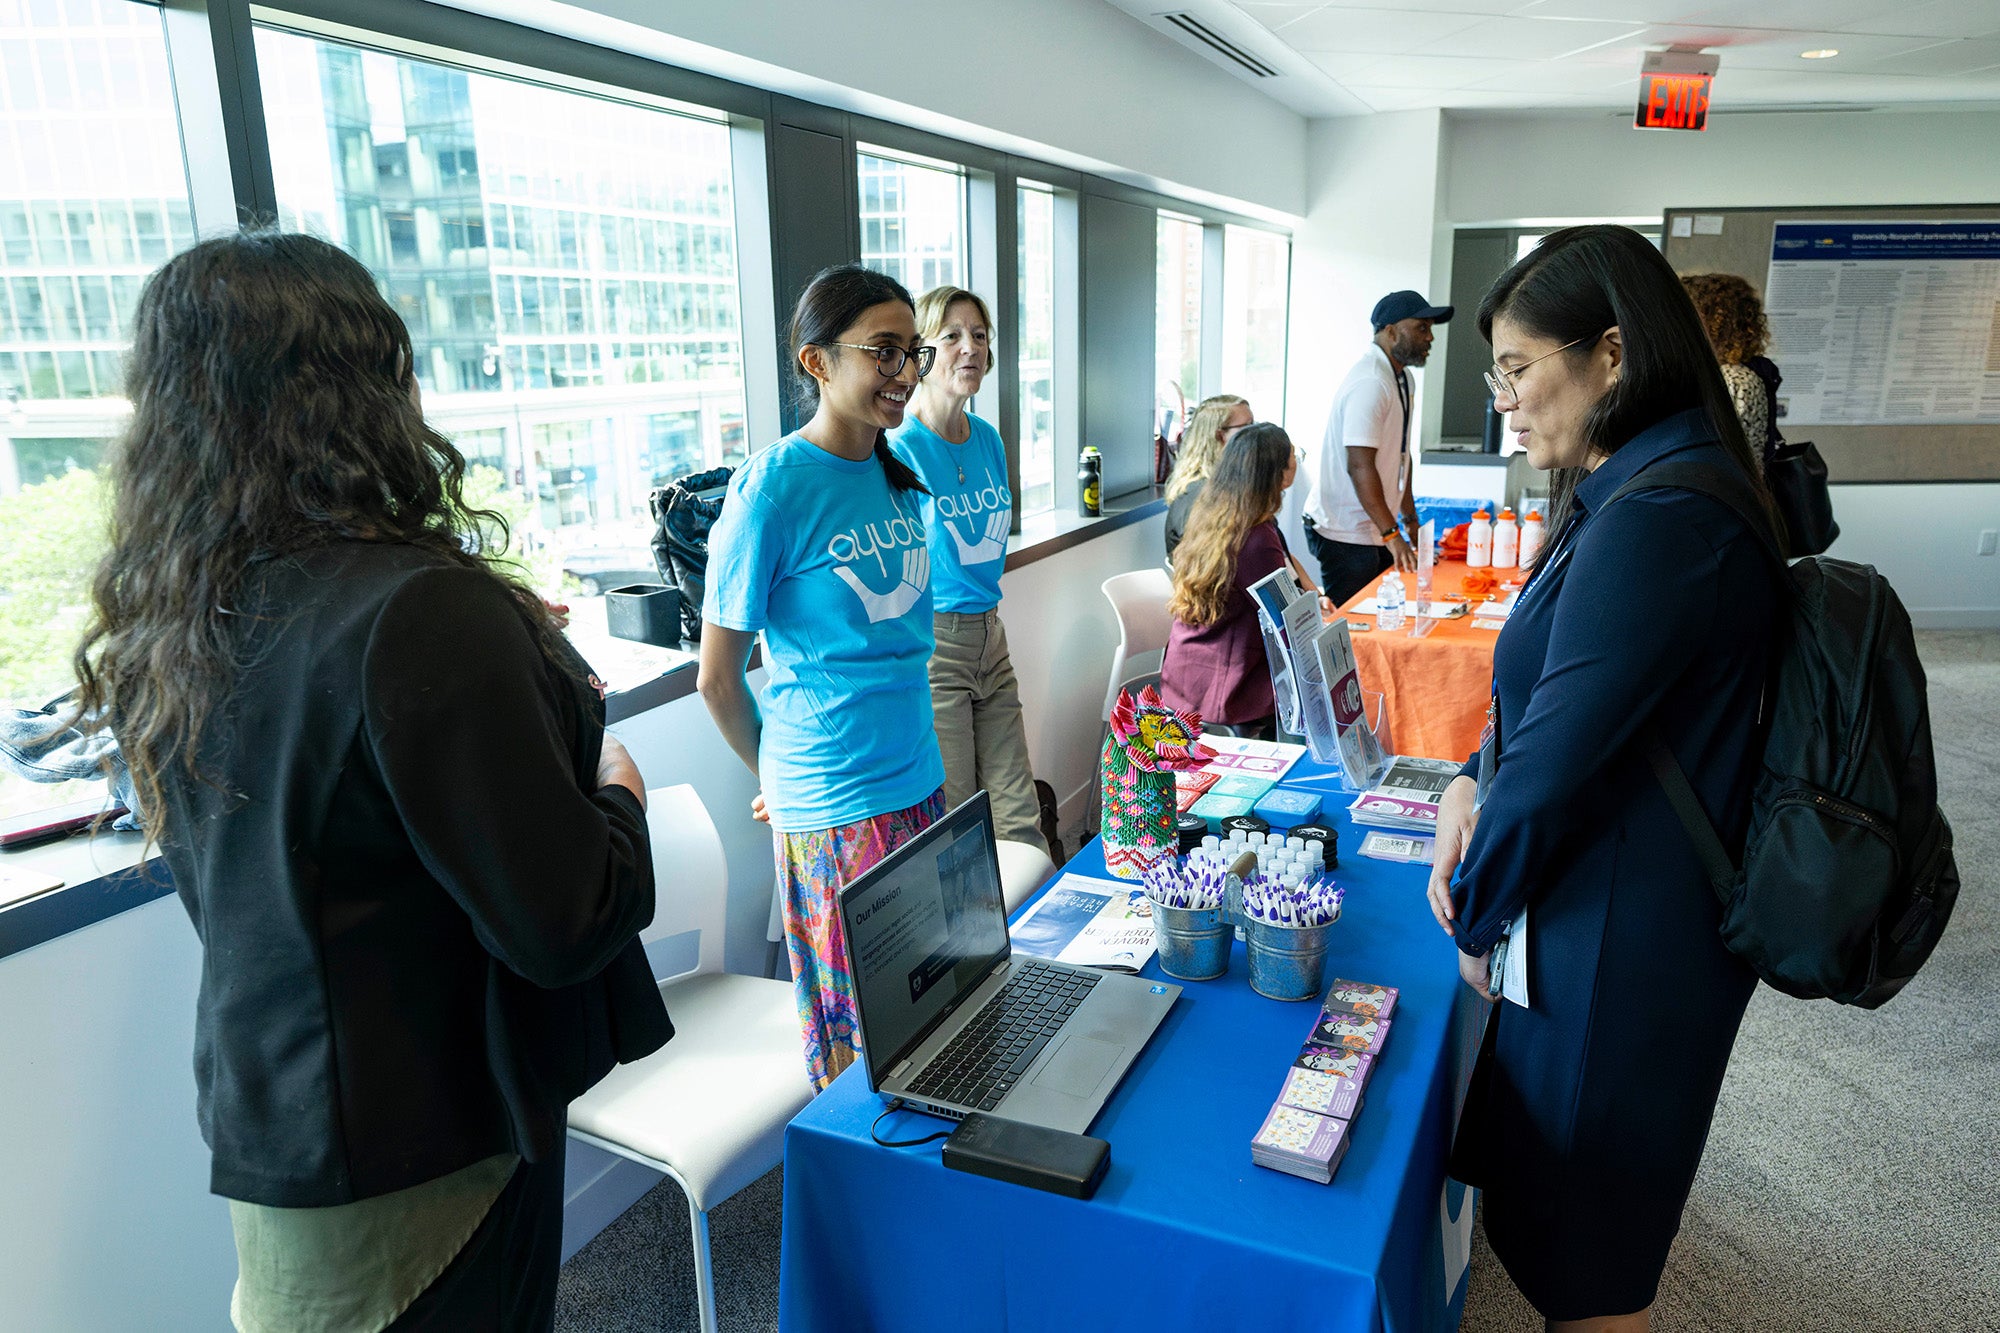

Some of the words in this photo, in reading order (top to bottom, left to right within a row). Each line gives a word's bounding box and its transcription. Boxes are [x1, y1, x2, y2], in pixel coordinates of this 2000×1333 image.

[1645, 77, 1704, 129] EXIT
[855, 909, 871, 925] Our
[872, 886, 902, 914] Mission
